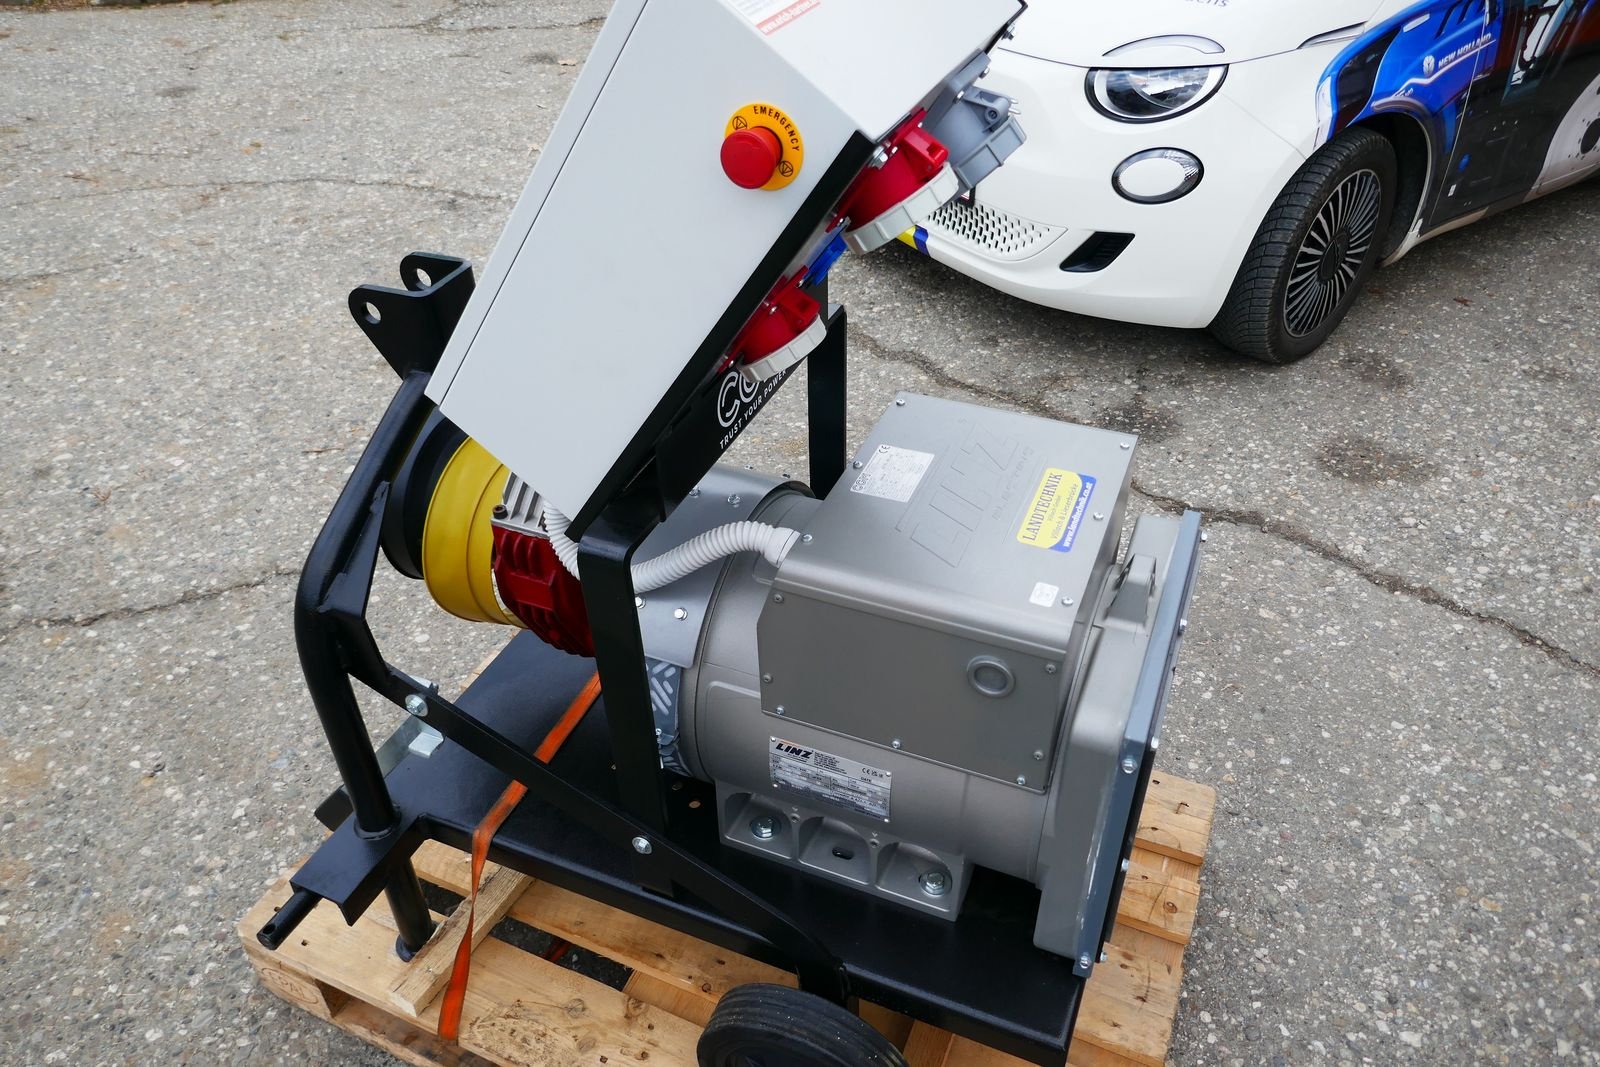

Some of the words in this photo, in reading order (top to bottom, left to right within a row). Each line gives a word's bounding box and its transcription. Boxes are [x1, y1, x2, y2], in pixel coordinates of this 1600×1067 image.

[1438, 51, 1457, 68] NEW
[1457, 32, 1492, 56] HOLLAND
[753, 105, 800, 152] EMERGENCY
[720, 417, 743, 450] TRUST
[743, 395, 762, 421] YOUR
[763, 369, 787, 398] POWER
[1022, 472, 1063, 541] LANDTECHNIK
[775, 742, 813, 759] LINZ
